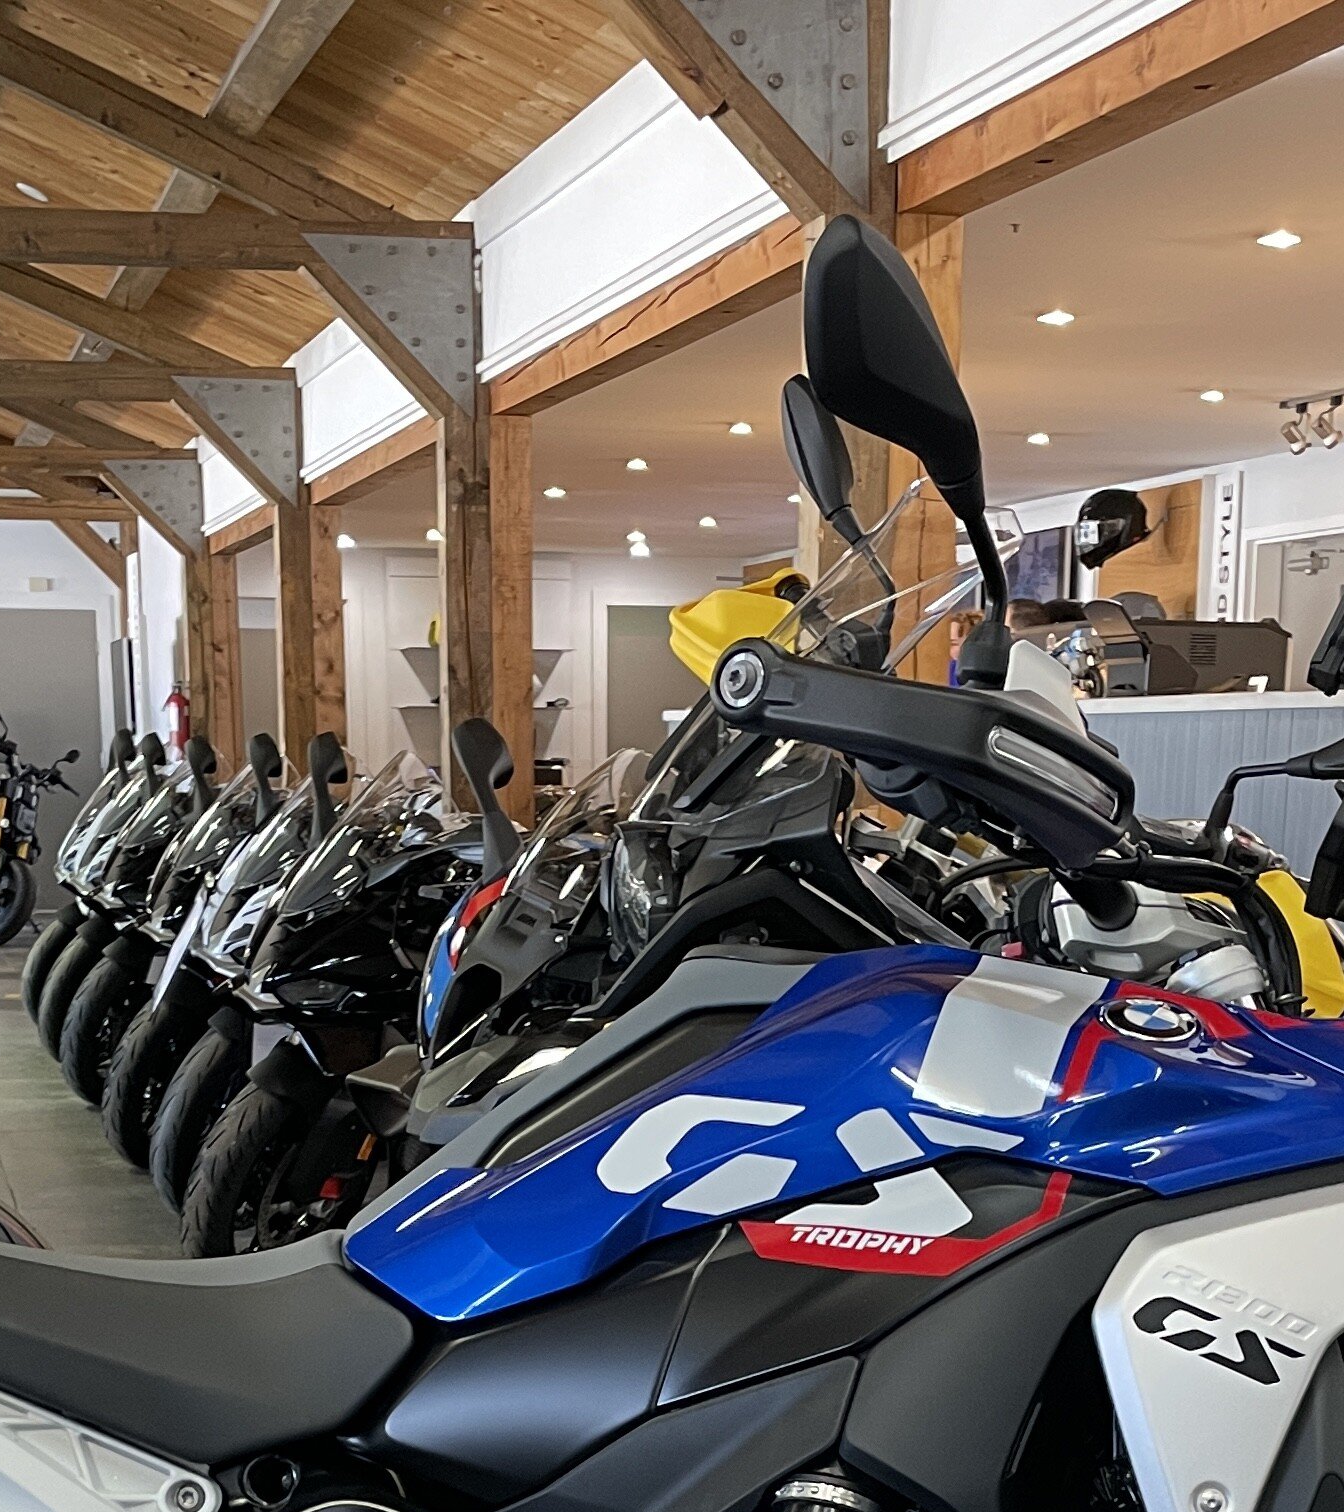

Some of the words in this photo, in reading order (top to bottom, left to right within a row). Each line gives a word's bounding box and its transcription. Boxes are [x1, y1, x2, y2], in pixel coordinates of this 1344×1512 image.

[1218, 484, 1234, 584] STYLE
[596, 1094, 1024, 1237] GS
[789, 1225, 936, 1256] TROPHY
[1132, 1296, 1306, 1386] GS
[1162, 1264, 1319, 1342] R1300
